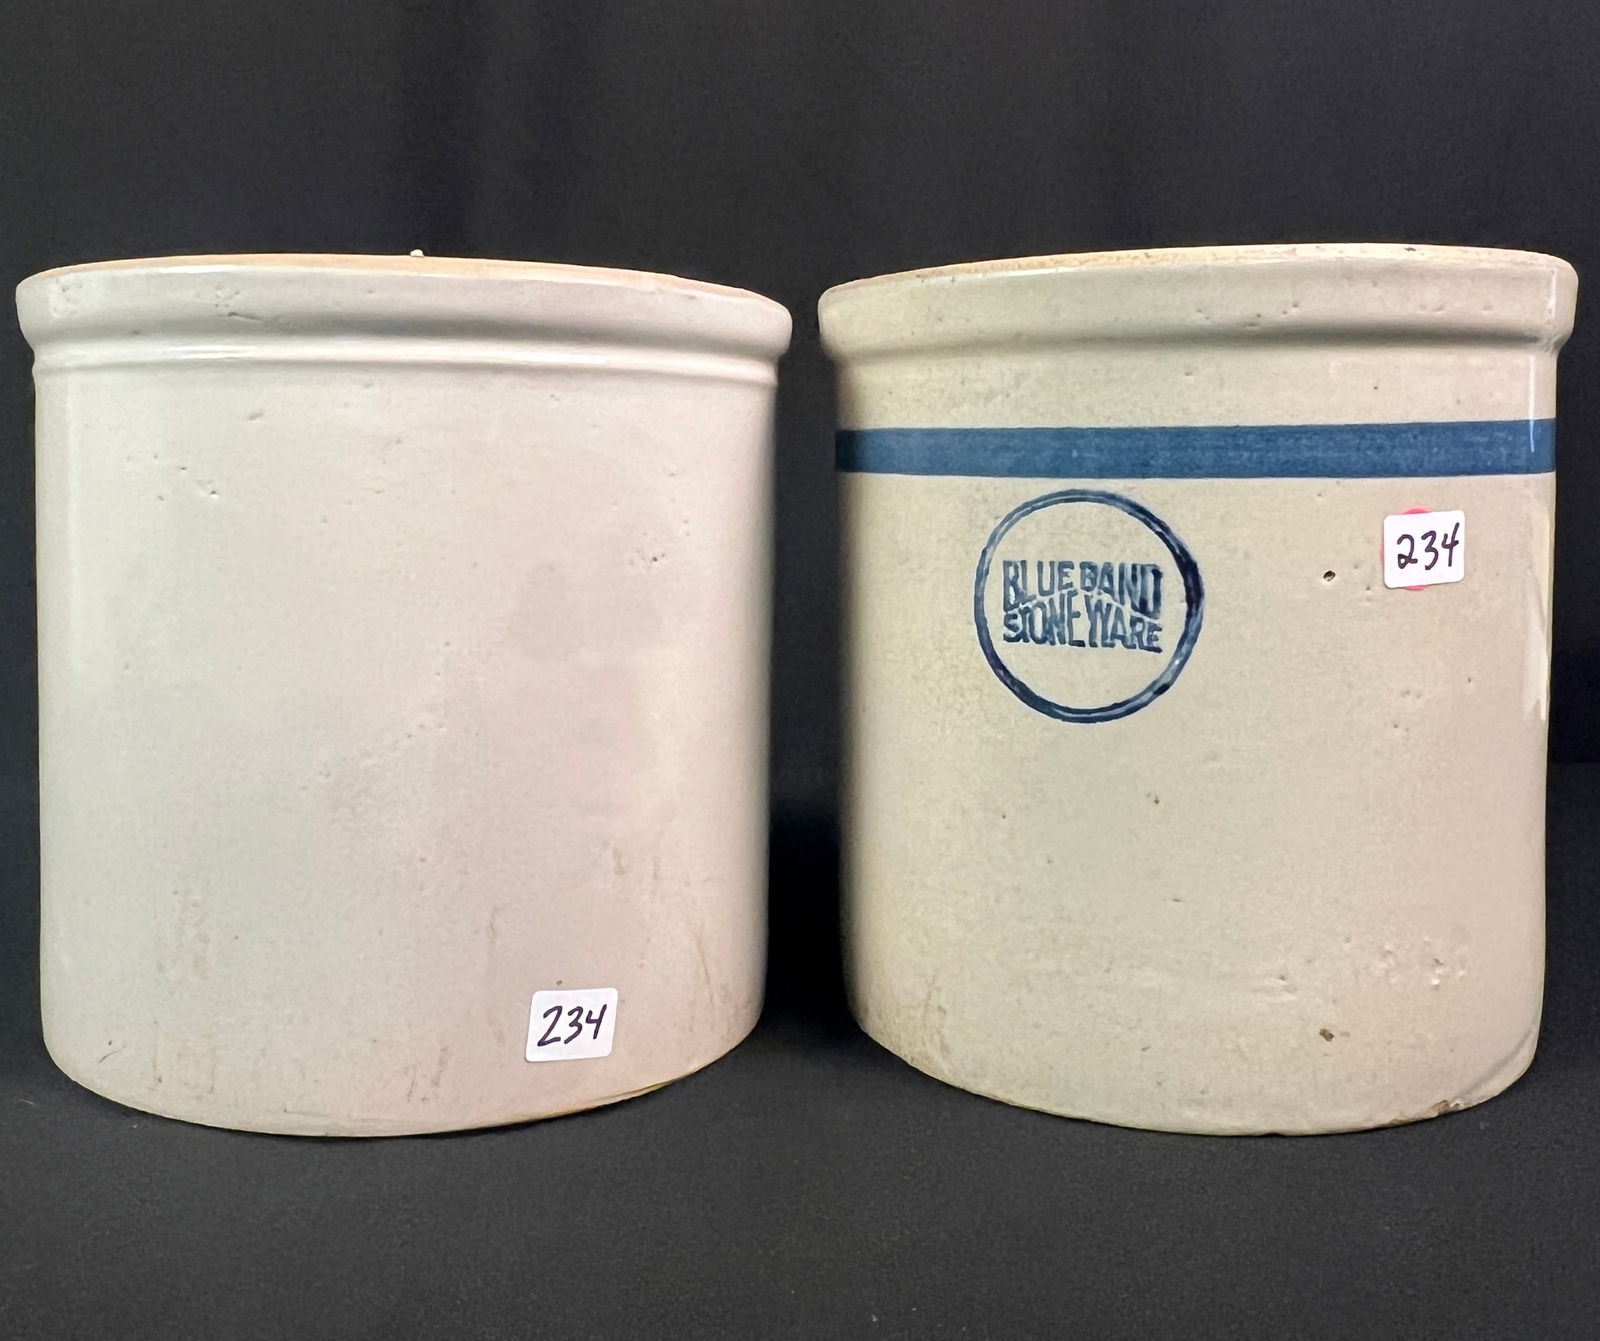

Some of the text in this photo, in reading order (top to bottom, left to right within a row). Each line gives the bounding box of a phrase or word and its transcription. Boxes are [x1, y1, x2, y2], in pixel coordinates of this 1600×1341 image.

[1396, 521, 1460, 571] 234
[1003, 560, 1163, 620] BLUE BAND
[537, 1003, 608, 1047] 234
